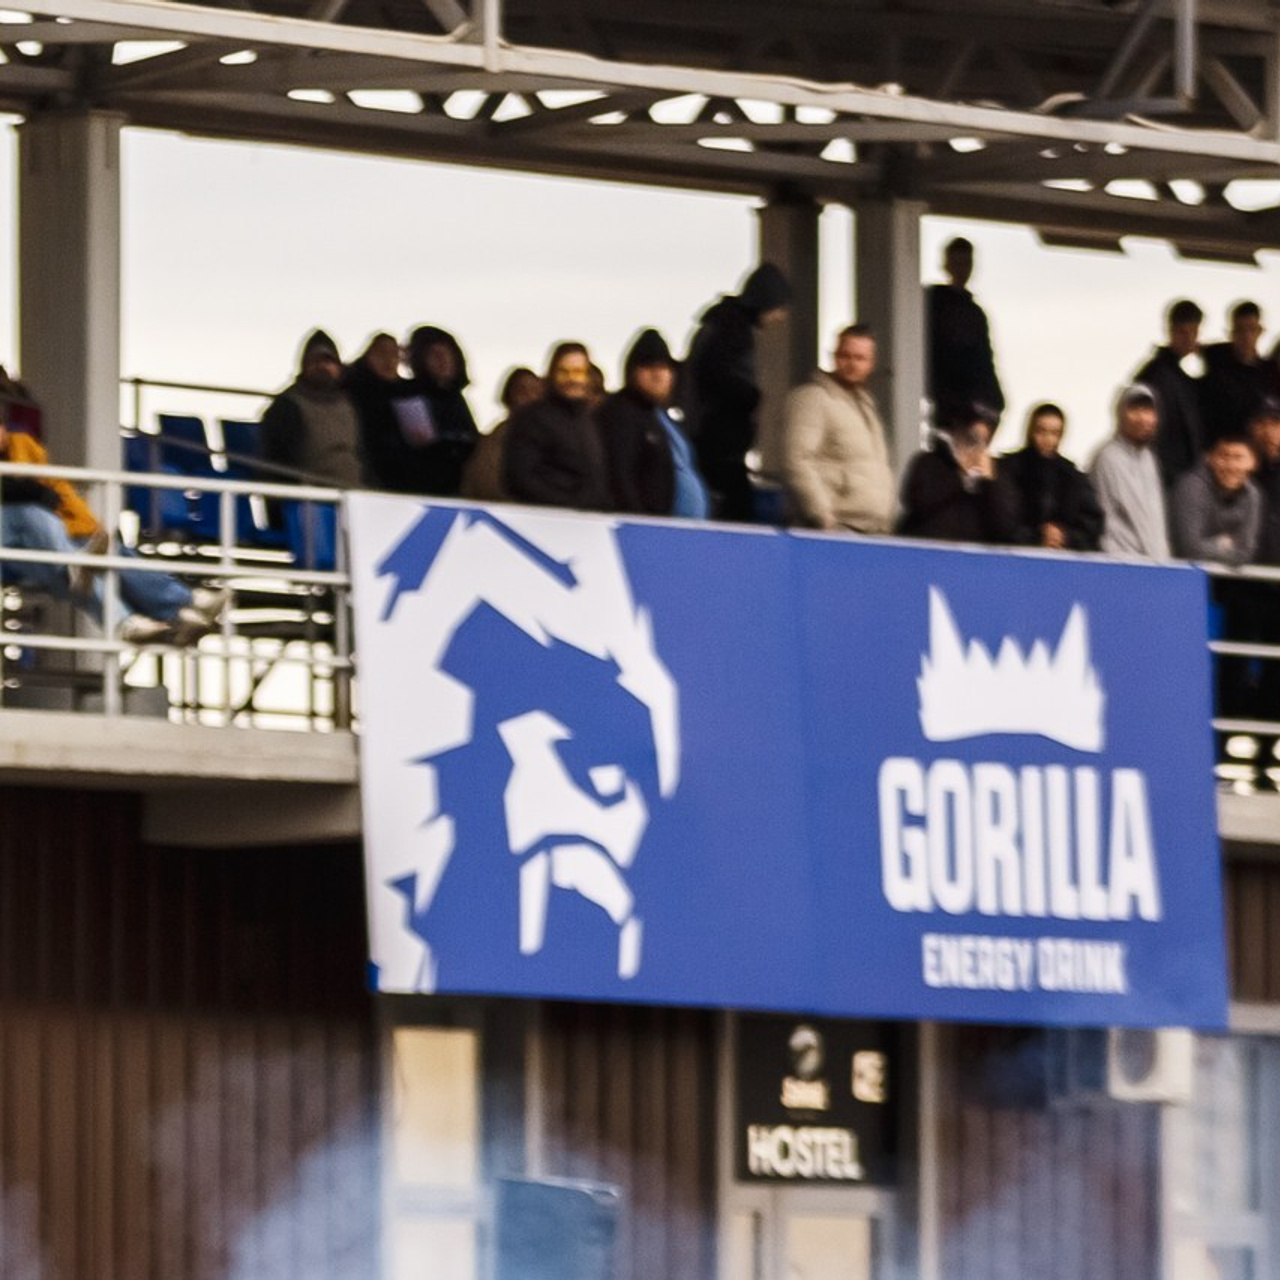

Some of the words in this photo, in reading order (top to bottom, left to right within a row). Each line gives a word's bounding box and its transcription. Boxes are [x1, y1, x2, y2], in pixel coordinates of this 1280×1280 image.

[877, 756, 1163, 923] GORILLA
[922, 933, 1033, 992] ENERGY
[1036, 936, 1128, 995] DRINK
[747, 1124, 867, 1181] HOSTEL
